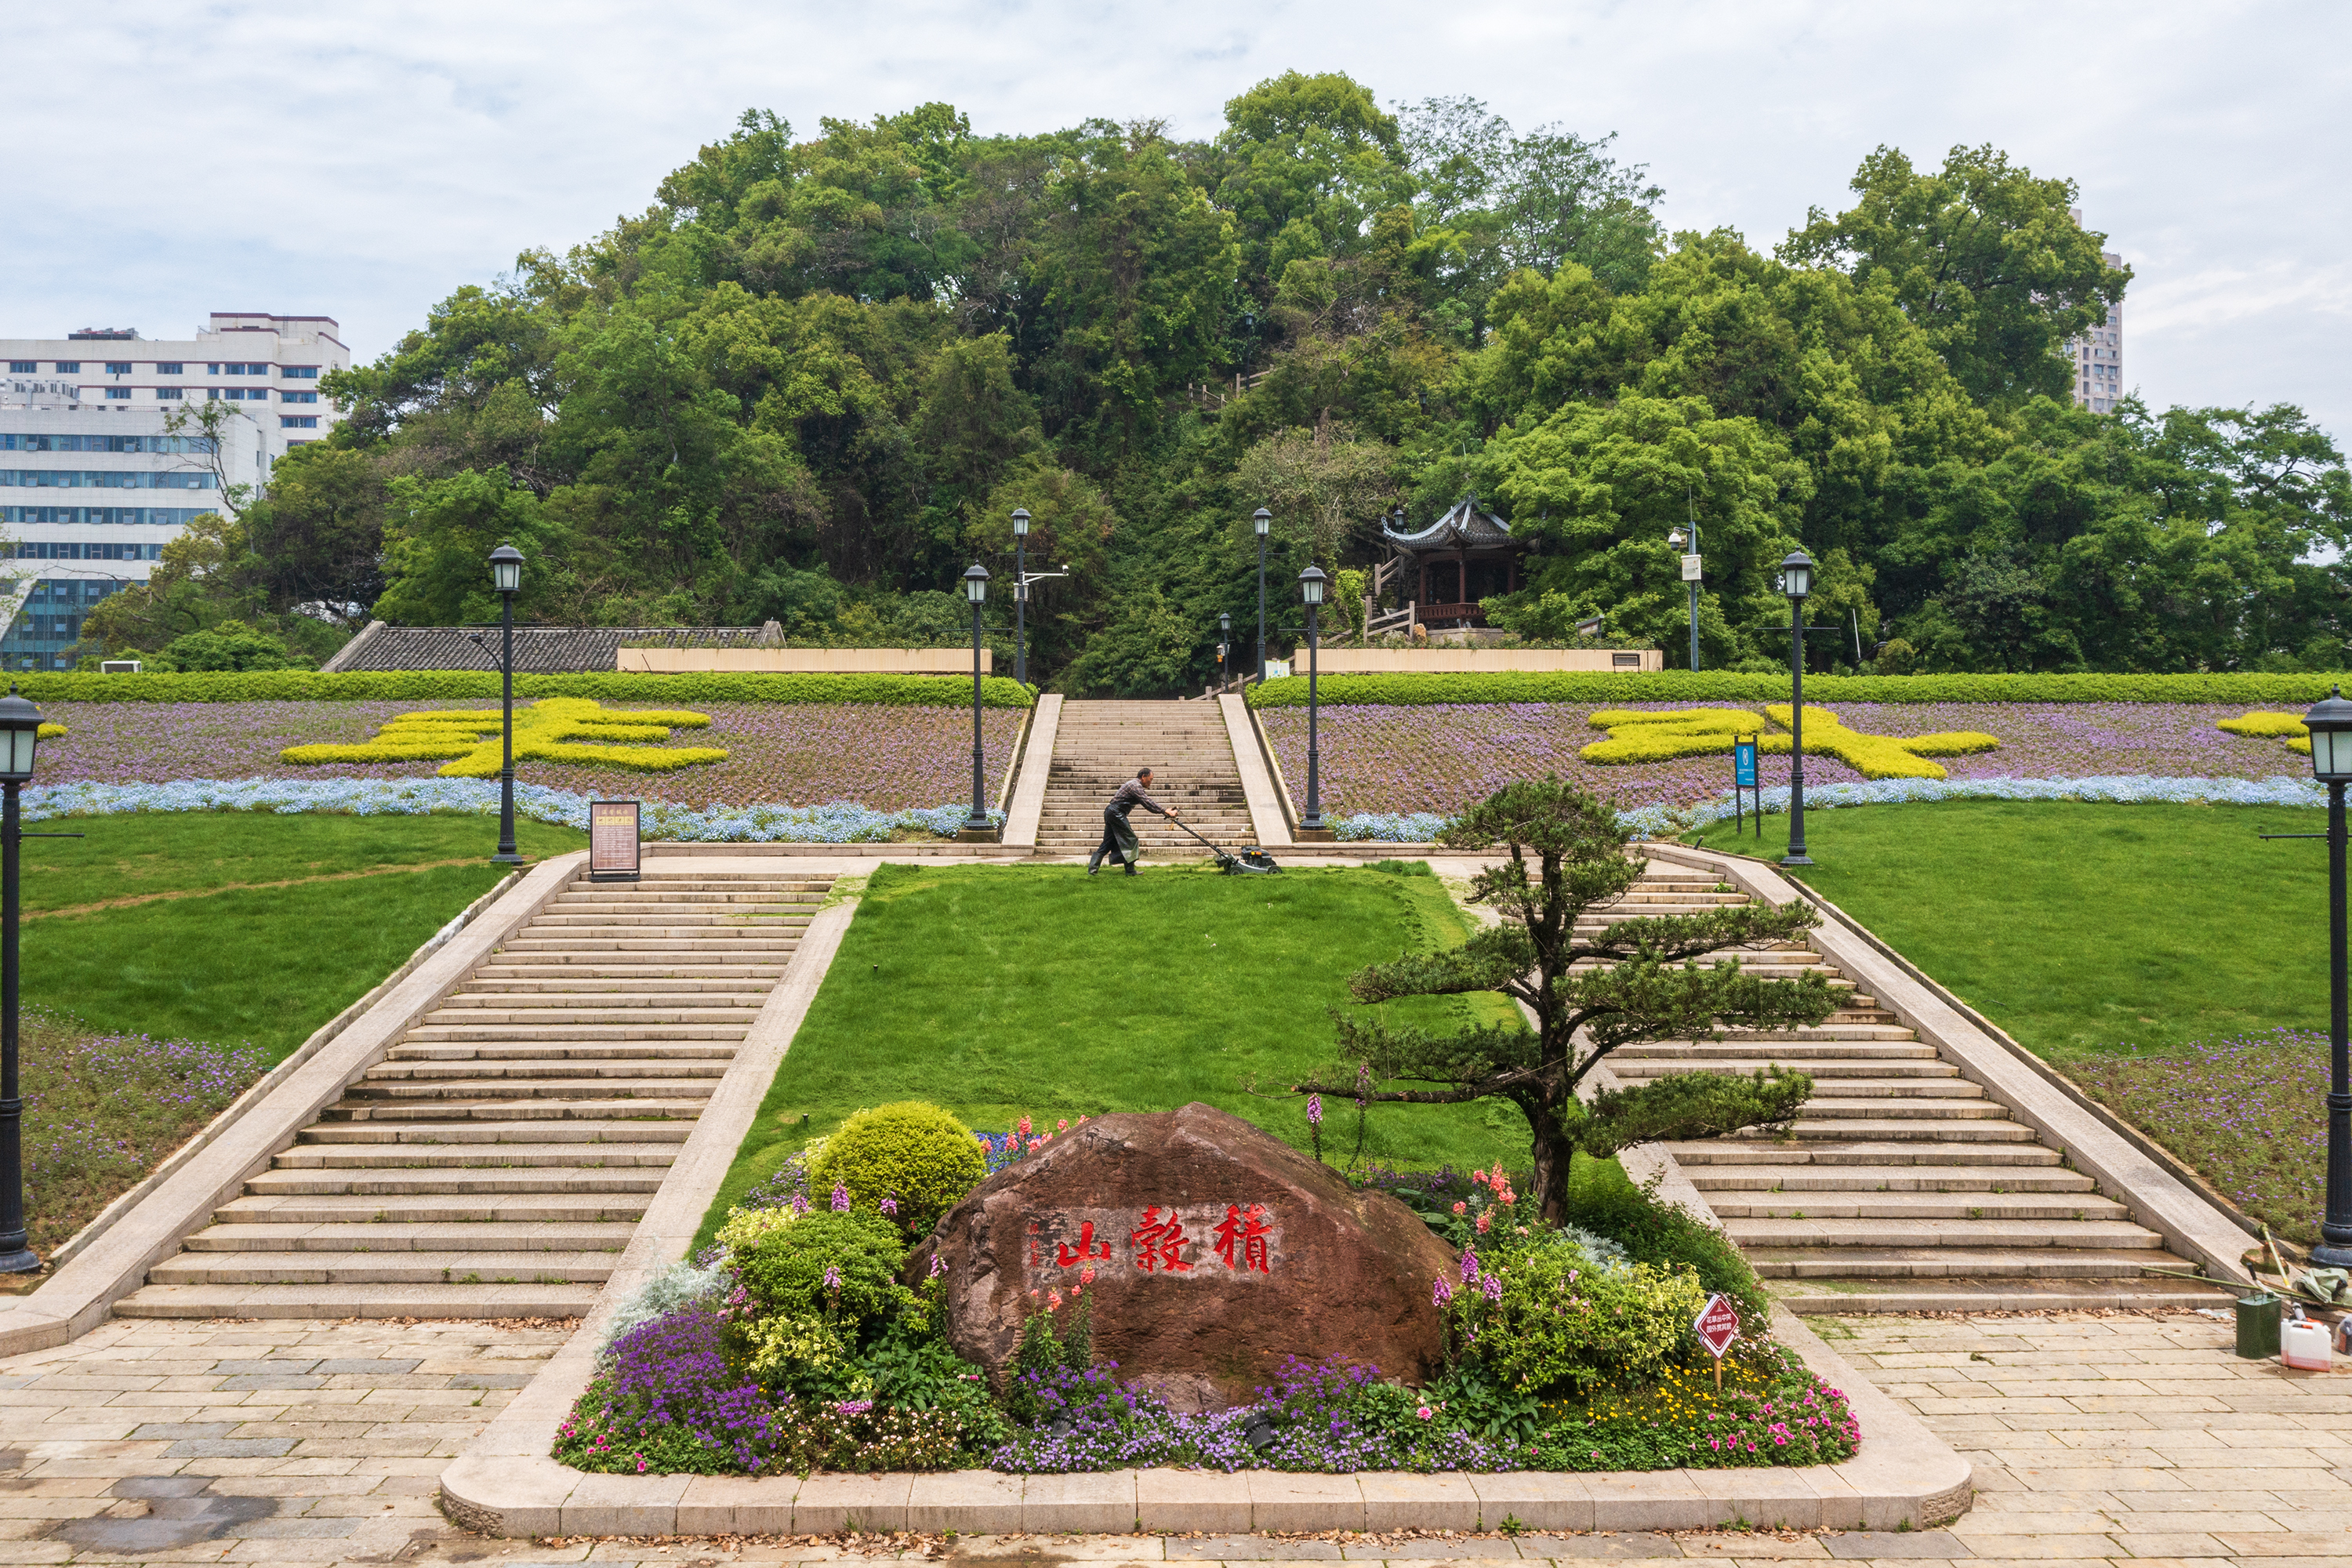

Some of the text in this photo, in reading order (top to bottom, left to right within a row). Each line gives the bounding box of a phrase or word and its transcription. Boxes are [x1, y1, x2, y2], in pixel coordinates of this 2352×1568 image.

[1707, 1313, 1732, 1323] 花草丛中笑
